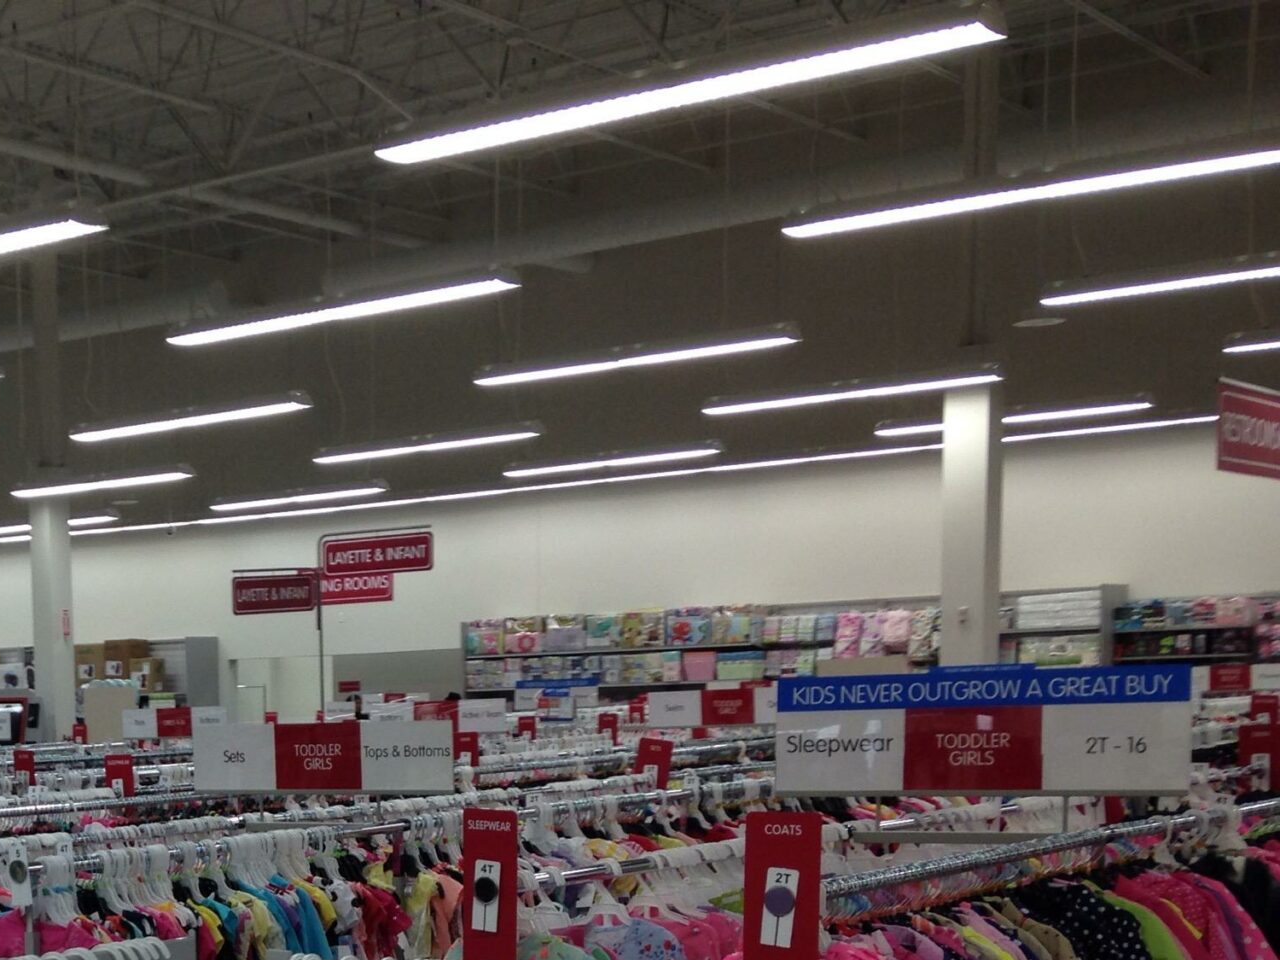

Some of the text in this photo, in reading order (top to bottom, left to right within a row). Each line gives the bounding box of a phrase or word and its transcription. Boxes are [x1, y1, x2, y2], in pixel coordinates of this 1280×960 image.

[329, 545, 426, 565] LAYETTE & INFANT
[344, 575, 389, 591] ROOMS
[793, 685, 836, 705] KIDS
[841, 683, 903, 704] NEVER
[908, 680, 1020, 702] OUTGROW
[1026, 679, 1043, 697] A
[1048, 676, 1120, 698] GREAT
[1125, 674, 1173, 696] BUY
[787, 735, 894, 757] Sleepwear
[936, 733, 1011, 749] TODDLER
[1086, 736, 1110, 754] 2T
[1127, 736, 1147, 754] 16
[223, 750, 245, 763] Sets
[294, 743, 341, 757] TODDLER
[363, 745, 451, 759] Tops & Bottoms
[304, 758, 333, 770] GIRLS
[949, 750, 995, 766] GIRLS
[467, 819, 511, 832] SLEEPWEAR
[764, 824, 802, 836] COATS
[480, 863, 494, 875] 4T
[775, 872, 791, 885] 2T
